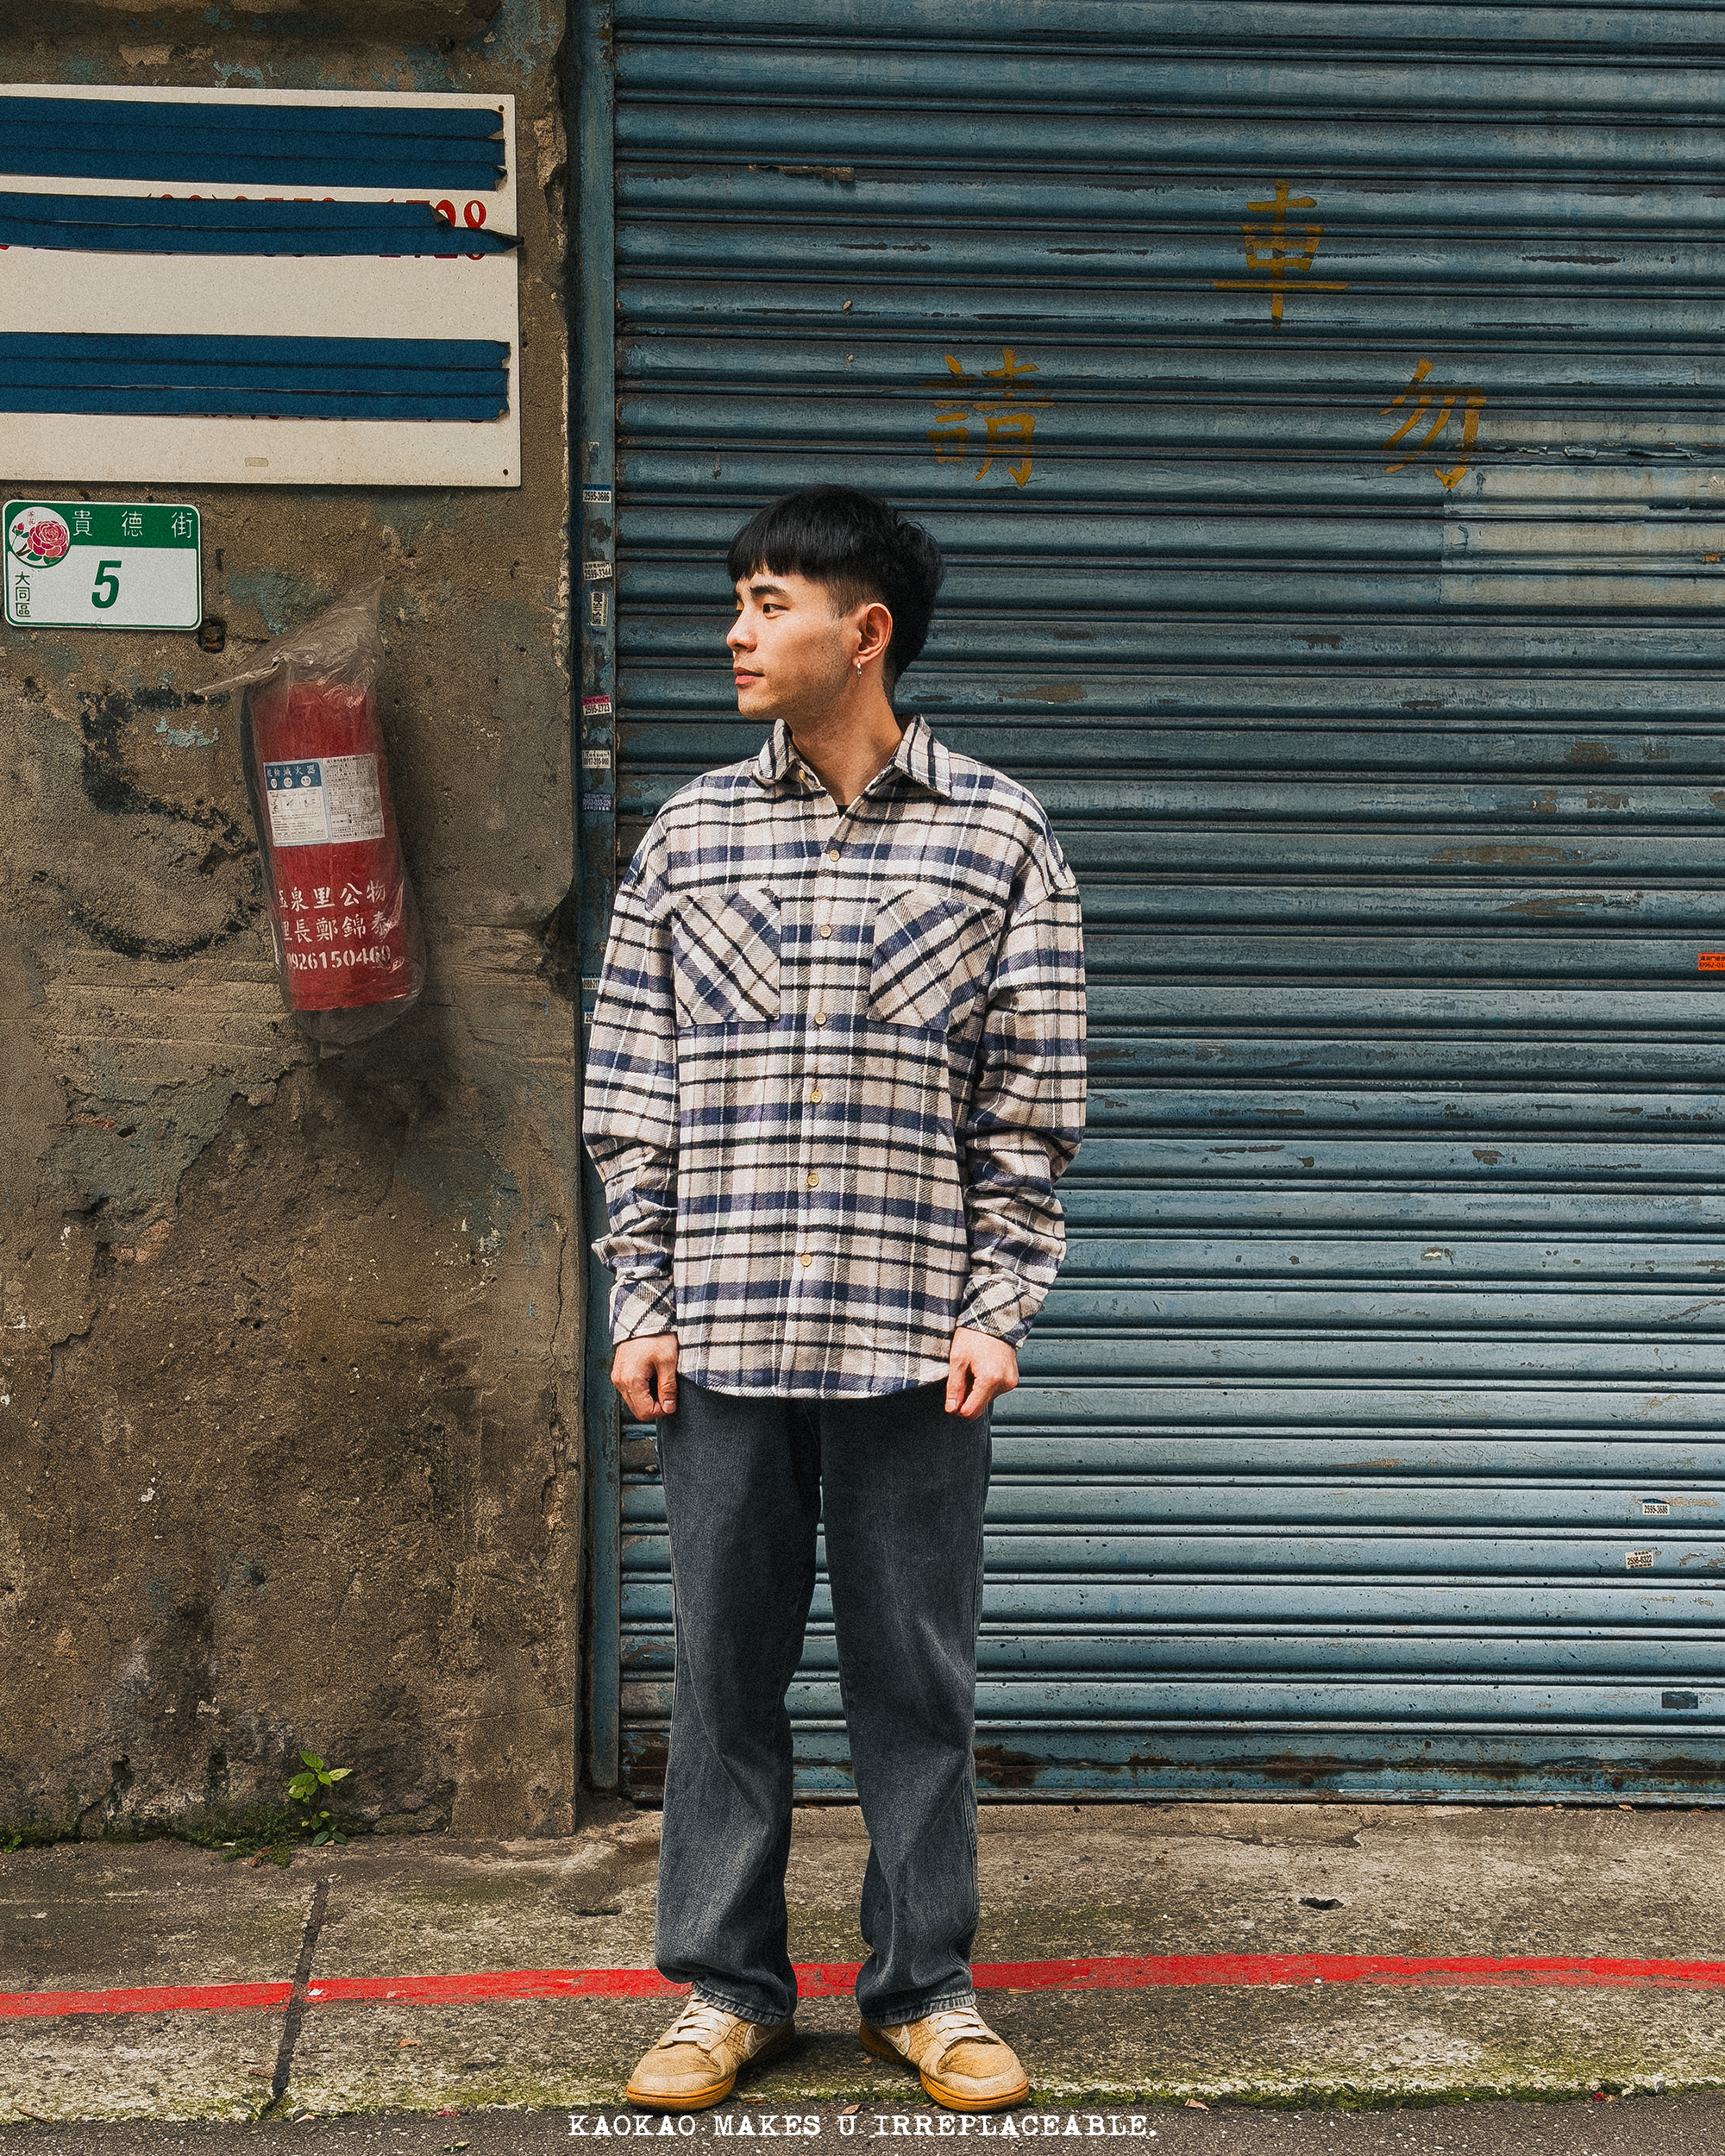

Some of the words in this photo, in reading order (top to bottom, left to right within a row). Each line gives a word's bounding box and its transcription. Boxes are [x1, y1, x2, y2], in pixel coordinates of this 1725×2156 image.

[1212, 179, 1349, 330] 車
[922, 348, 1056, 488] 請
[1379, 358, 1487, 491] 勿
[72, 510, 193, 539] 貴德街
[15, 571, 31, 617] 大同區
[91, 560, 122, 609] 5
